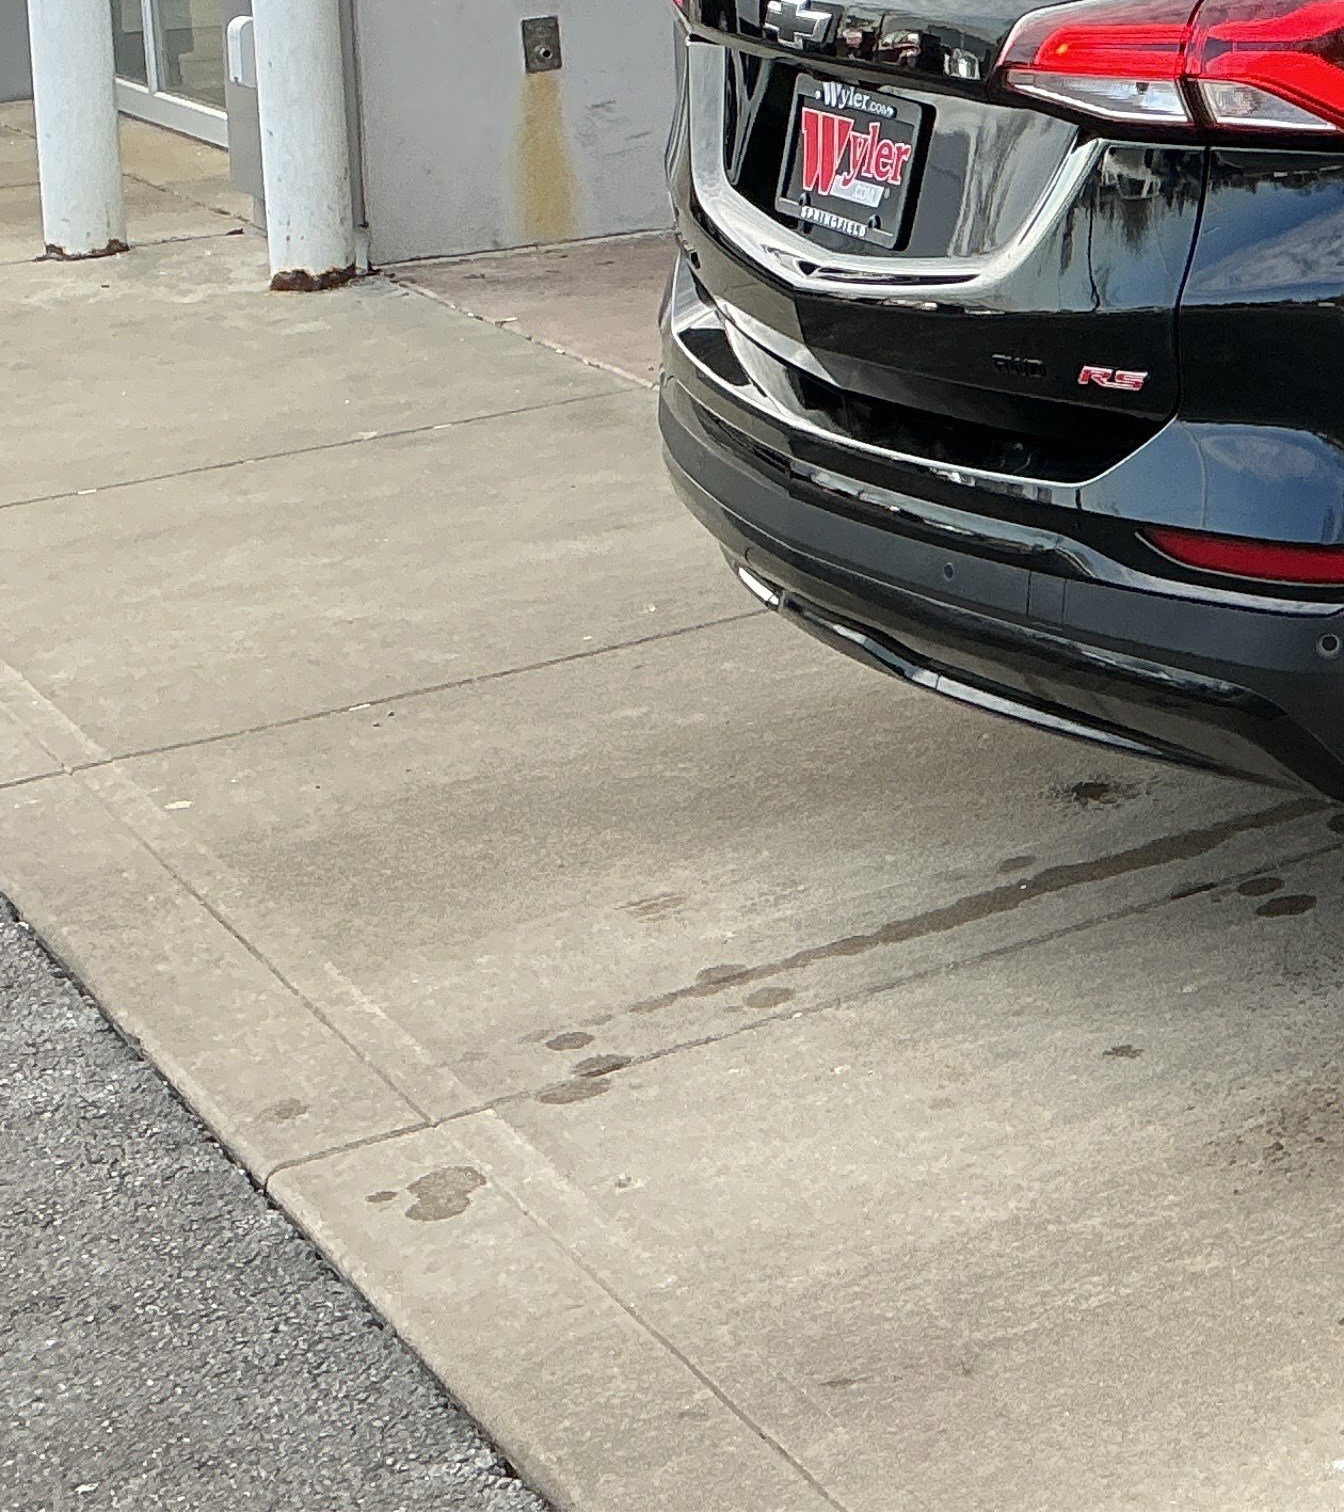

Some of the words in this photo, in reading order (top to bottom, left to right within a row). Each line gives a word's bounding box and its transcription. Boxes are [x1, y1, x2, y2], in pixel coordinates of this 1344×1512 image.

[801, 107, 911, 195] Wyler
[800, 205, 867, 238] SPRINGFIELD
[1077, 365, 1148, 391] RS
